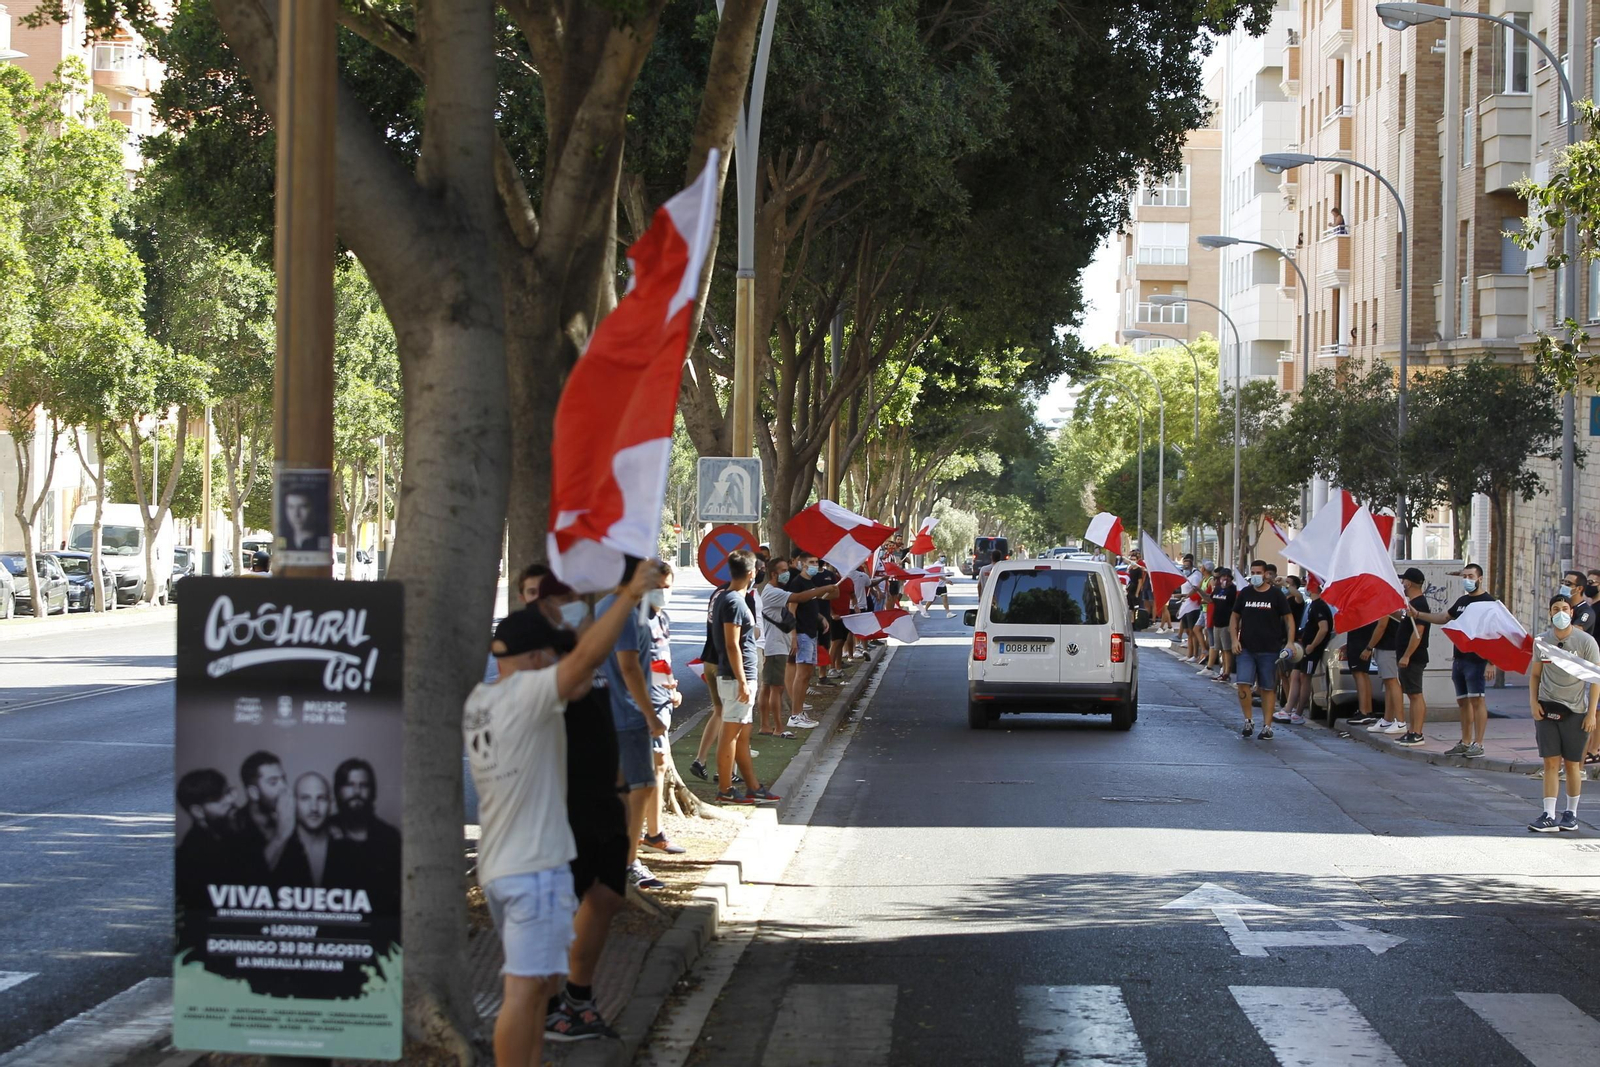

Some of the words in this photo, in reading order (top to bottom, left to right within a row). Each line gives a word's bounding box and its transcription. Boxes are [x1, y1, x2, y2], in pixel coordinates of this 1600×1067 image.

[1005, 643, 1028, 653] 0088
[1030, 644, 1047, 653] KHT
[302, 701, 347, 713] MUSIC
[302, 713, 325, 723] FOR
[207, 884, 274, 908] VIVA
[277, 887, 372, 913] SUECIA
[270, 924, 318, 937] LOUDLY
[207, 939, 278, 954] DOMINGO
[296, 942, 315, 956] DE
[316, 943, 374, 958] AGOSTO
[236, 956, 249, 968] LA
[250, 957, 302, 970] MURALLA
